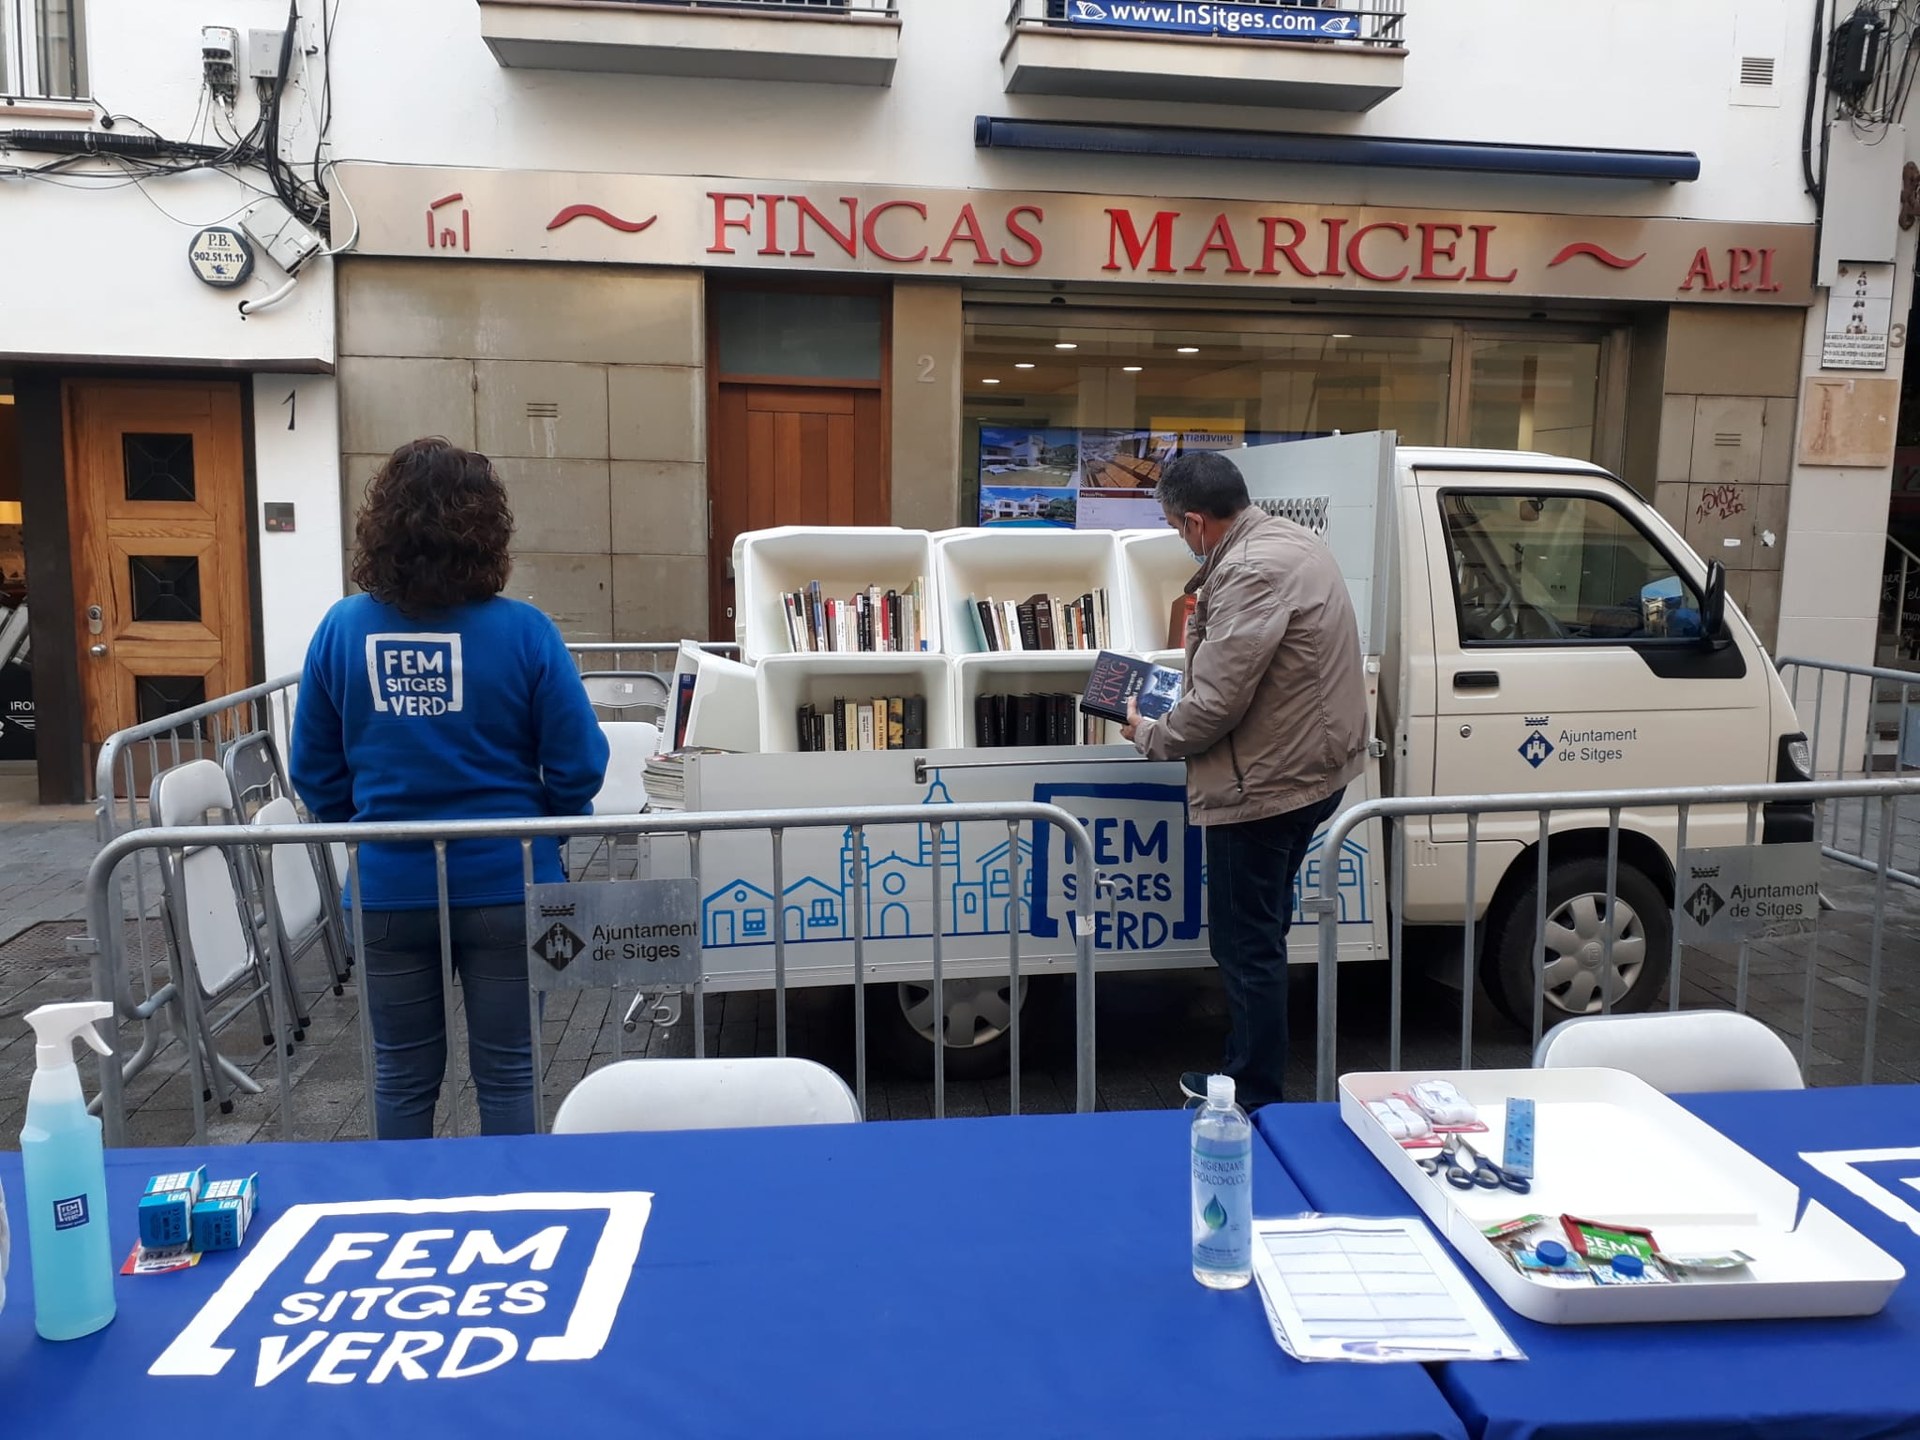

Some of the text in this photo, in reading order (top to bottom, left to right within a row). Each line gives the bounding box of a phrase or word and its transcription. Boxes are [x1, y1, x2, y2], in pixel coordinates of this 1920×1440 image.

[1111, 3, 1316, 31] www.InSitges.com
[208, 233, 231, 247] P.B.
[706, 191, 1783, 293] FINCAS MARICEL A.P.I.
[193, 251, 244, 263] 902.51.11.11
[1889, 322, 1906, 349] 3
[917, 353, 936, 384] 2
[281, 389, 296, 431] 1
[383, 649, 444, 675] FEM
[386, 677, 447, 693] SITGES
[1087, 657, 1111, 702] STEPHEN
[1098, 661, 1129, 706] KING
[389, 694, 447, 717] VERD
[1559, 728, 1637, 746] Ajuntament
[1559, 747, 1623, 763] de Sitges
[1730, 882, 1818, 903] Ajuntament
[1729, 902, 1803, 919] de Sitges
[592, 920, 698, 945] Ajuntament
[592, 943, 681, 963] de Sitges
[304, 1225, 568, 1284] FEM
[273, 1280, 548, 1327] SITGES
[254, 1327, 519, 1388] VERD
